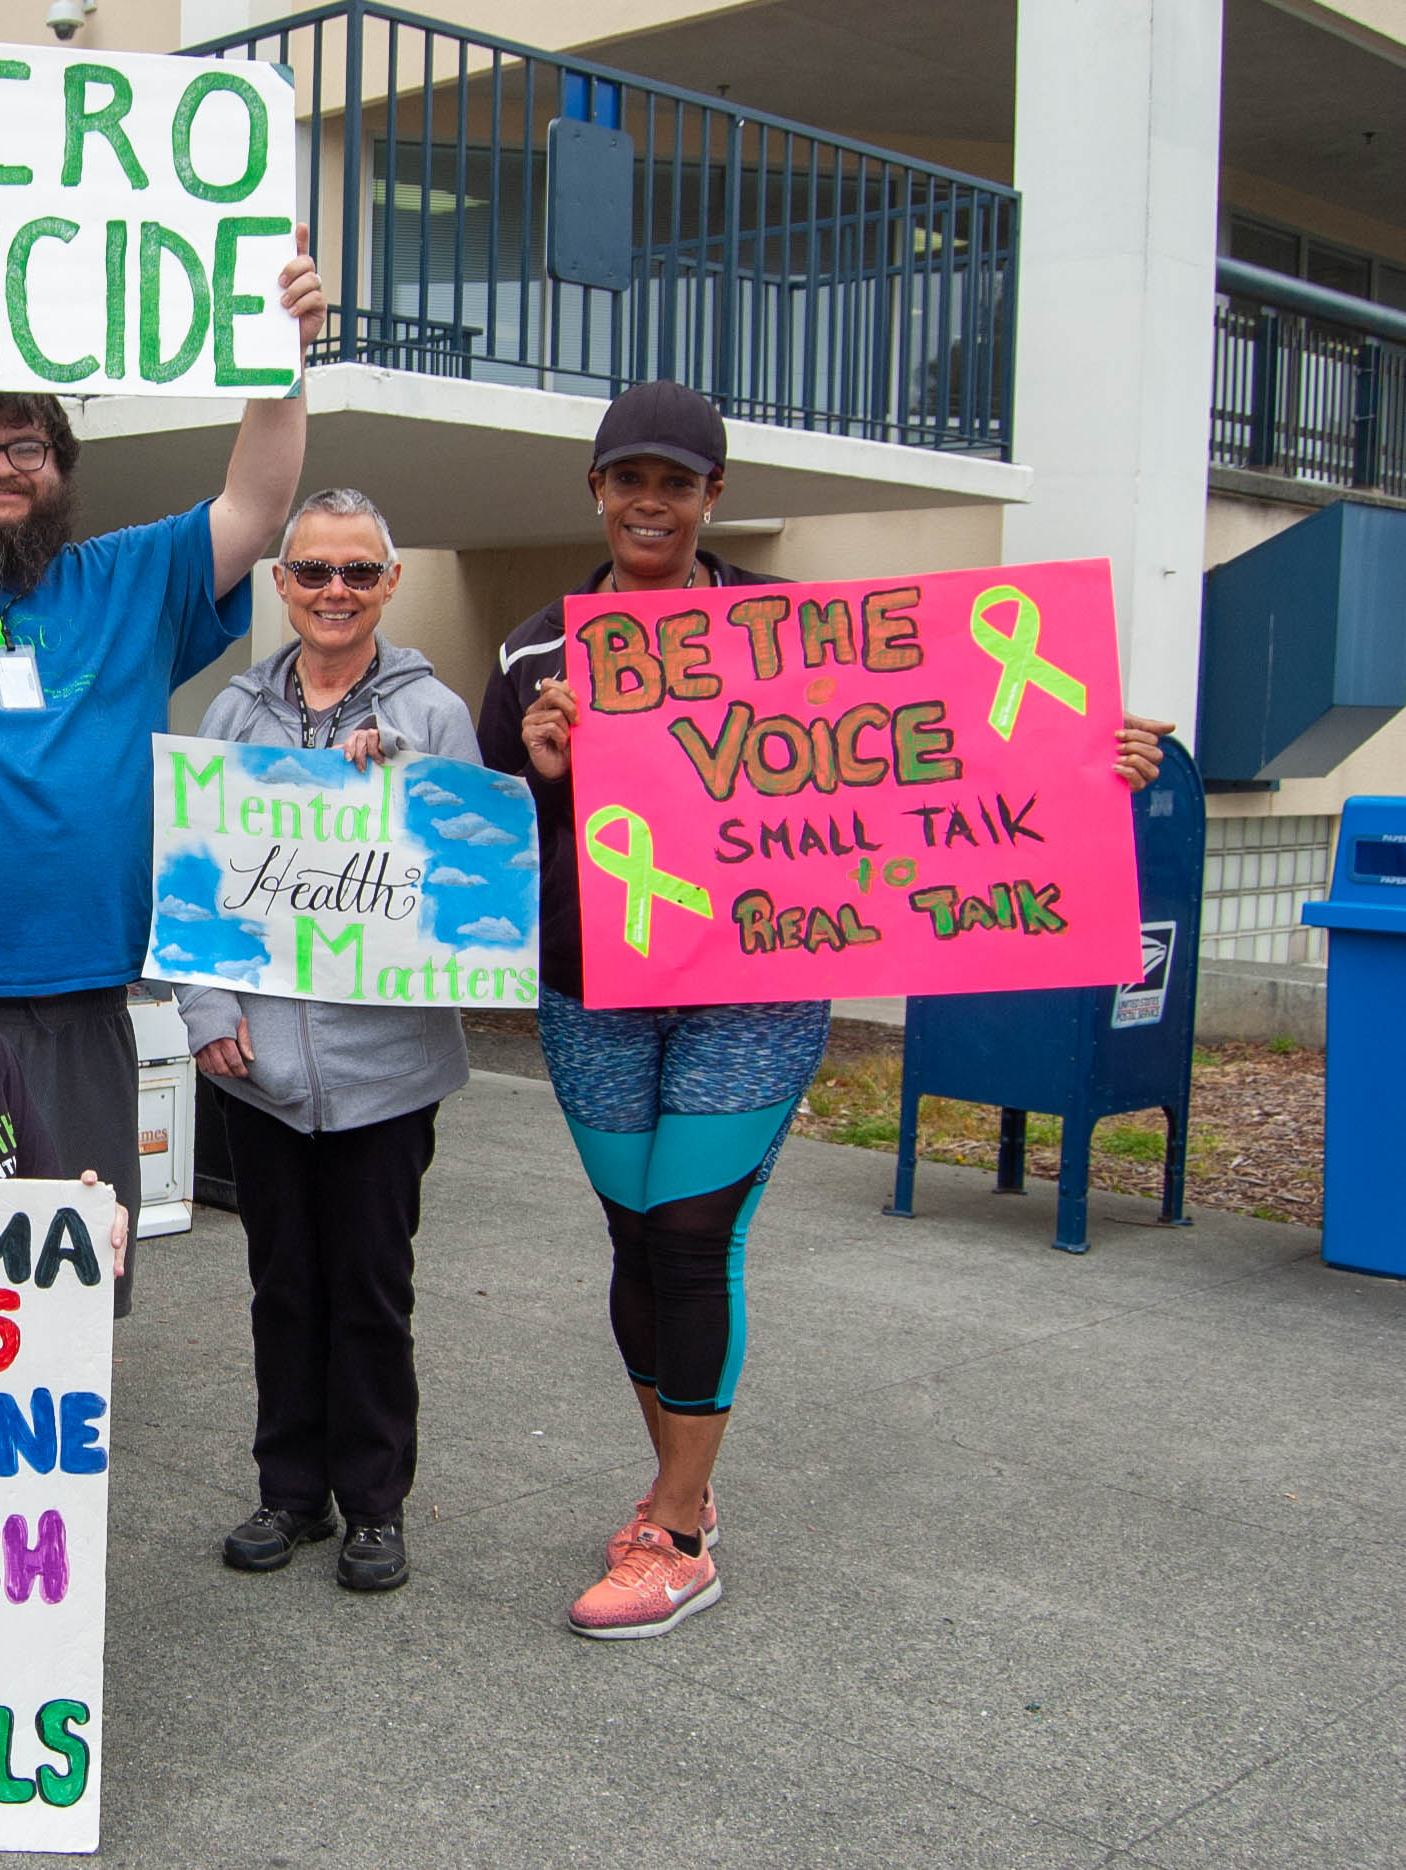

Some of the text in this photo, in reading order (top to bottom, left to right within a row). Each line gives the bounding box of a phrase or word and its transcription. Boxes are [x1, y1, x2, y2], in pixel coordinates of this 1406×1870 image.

[577, 586, 924, 714] BE THE
[668, 700, 963, 802] VOICE
[168, 751, 396, 844] Mental
[714, 808, 883, 864] SMALL
[223, 844, 422, 921] Health
[732, 888, 882, 955] REAL
[293, 915, 538, 1003] Matters
